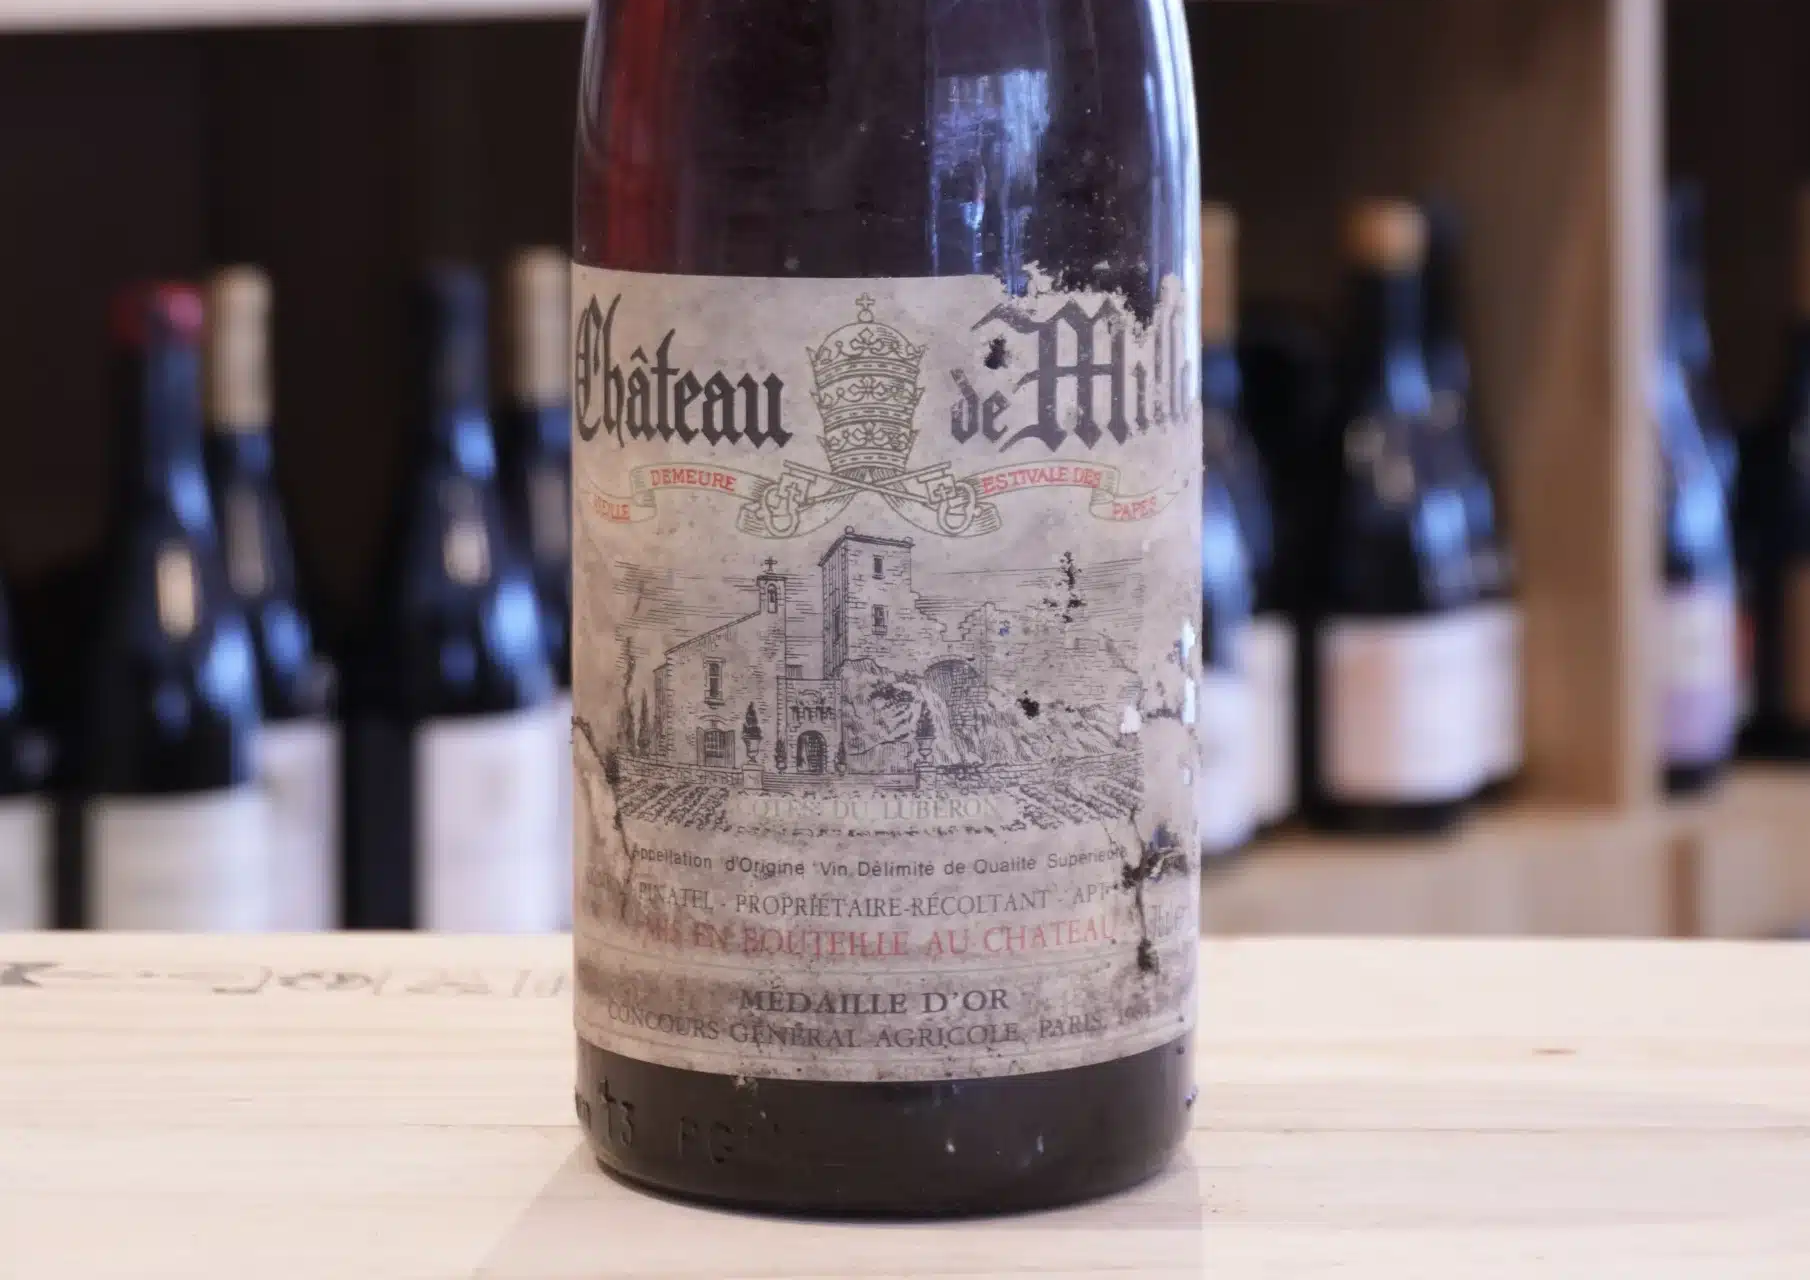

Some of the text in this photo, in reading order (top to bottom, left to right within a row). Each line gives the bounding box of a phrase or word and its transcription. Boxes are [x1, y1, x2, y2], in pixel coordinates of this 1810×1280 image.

[575, 293, 793, 449] Château
[950, 369, 1010, 444] de
[651, 468, 737, 492] DEMEURE
[983, 467, 1064, 494] ESTIVALE
[944, 860, 966, 876] de
[926, 928, 969, 957] AU
[922, 988, 1009, 1014] D'OR
